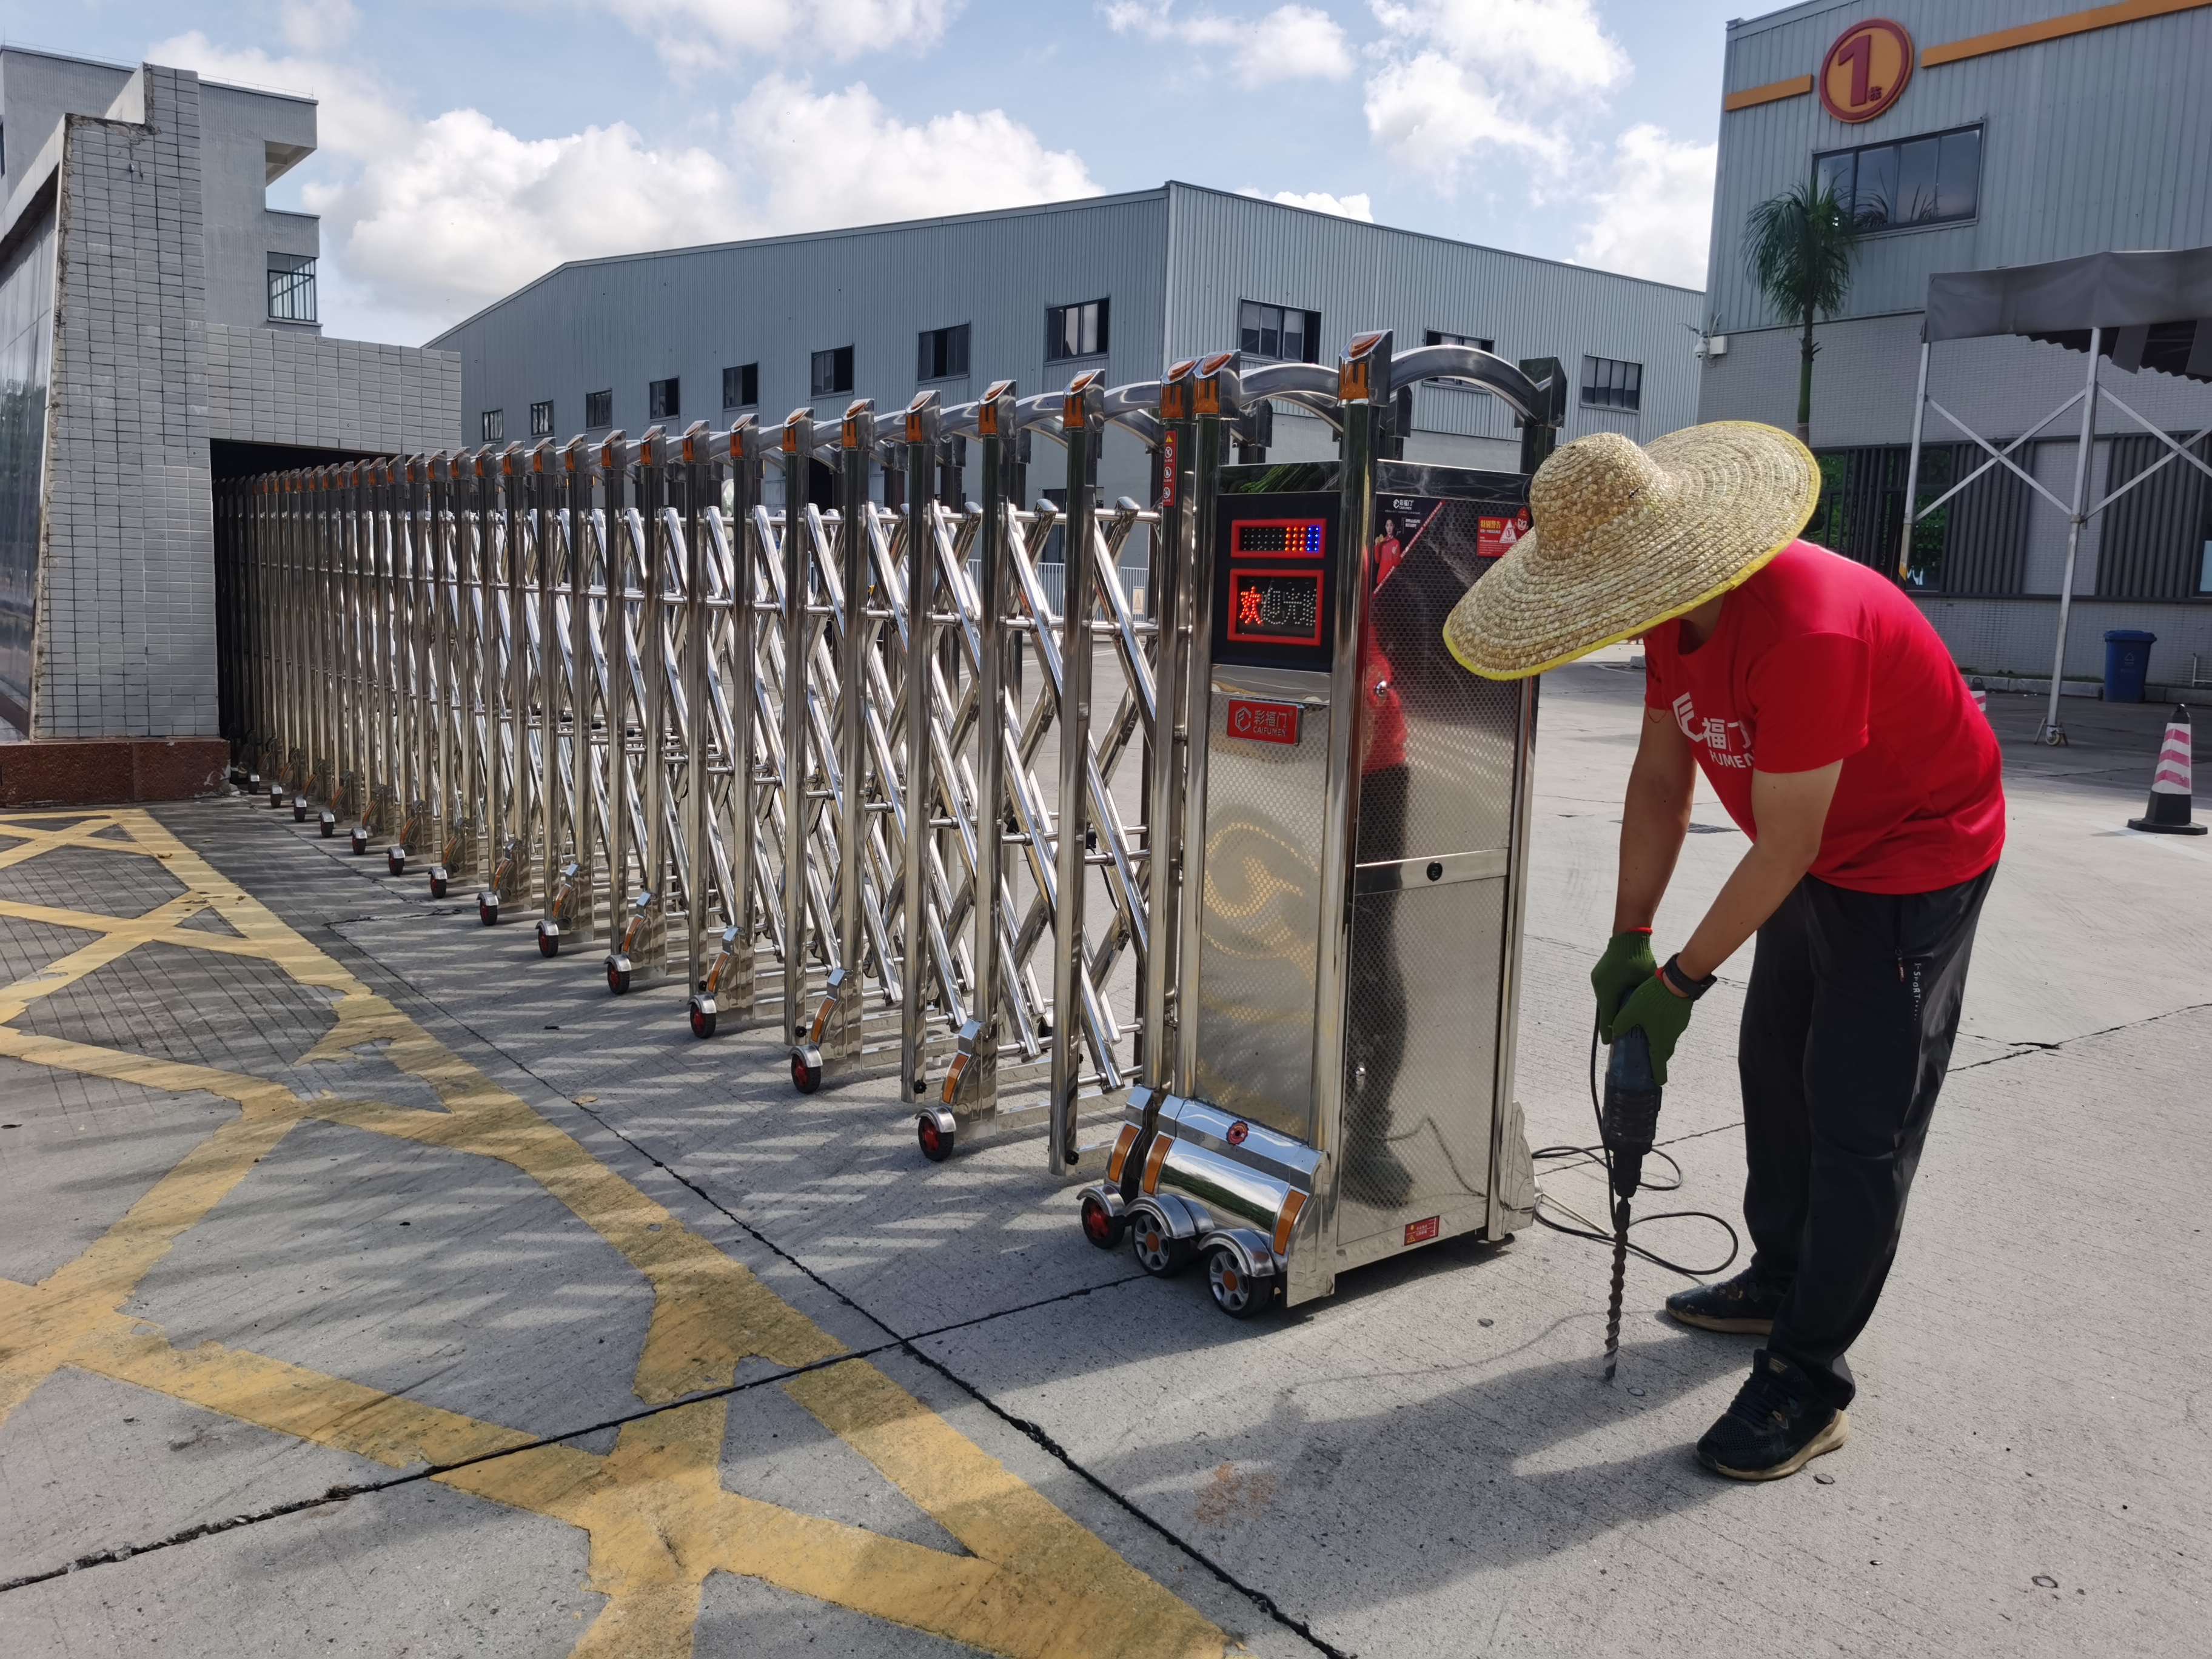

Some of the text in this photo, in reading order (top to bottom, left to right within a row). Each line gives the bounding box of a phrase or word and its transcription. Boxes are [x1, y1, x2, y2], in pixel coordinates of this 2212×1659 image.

[1838, 35, 1871, 107] 1
[1254, 710, 1287, 728] 彩福门
[1253, 726, 1286, 737] CAIFUMEN
